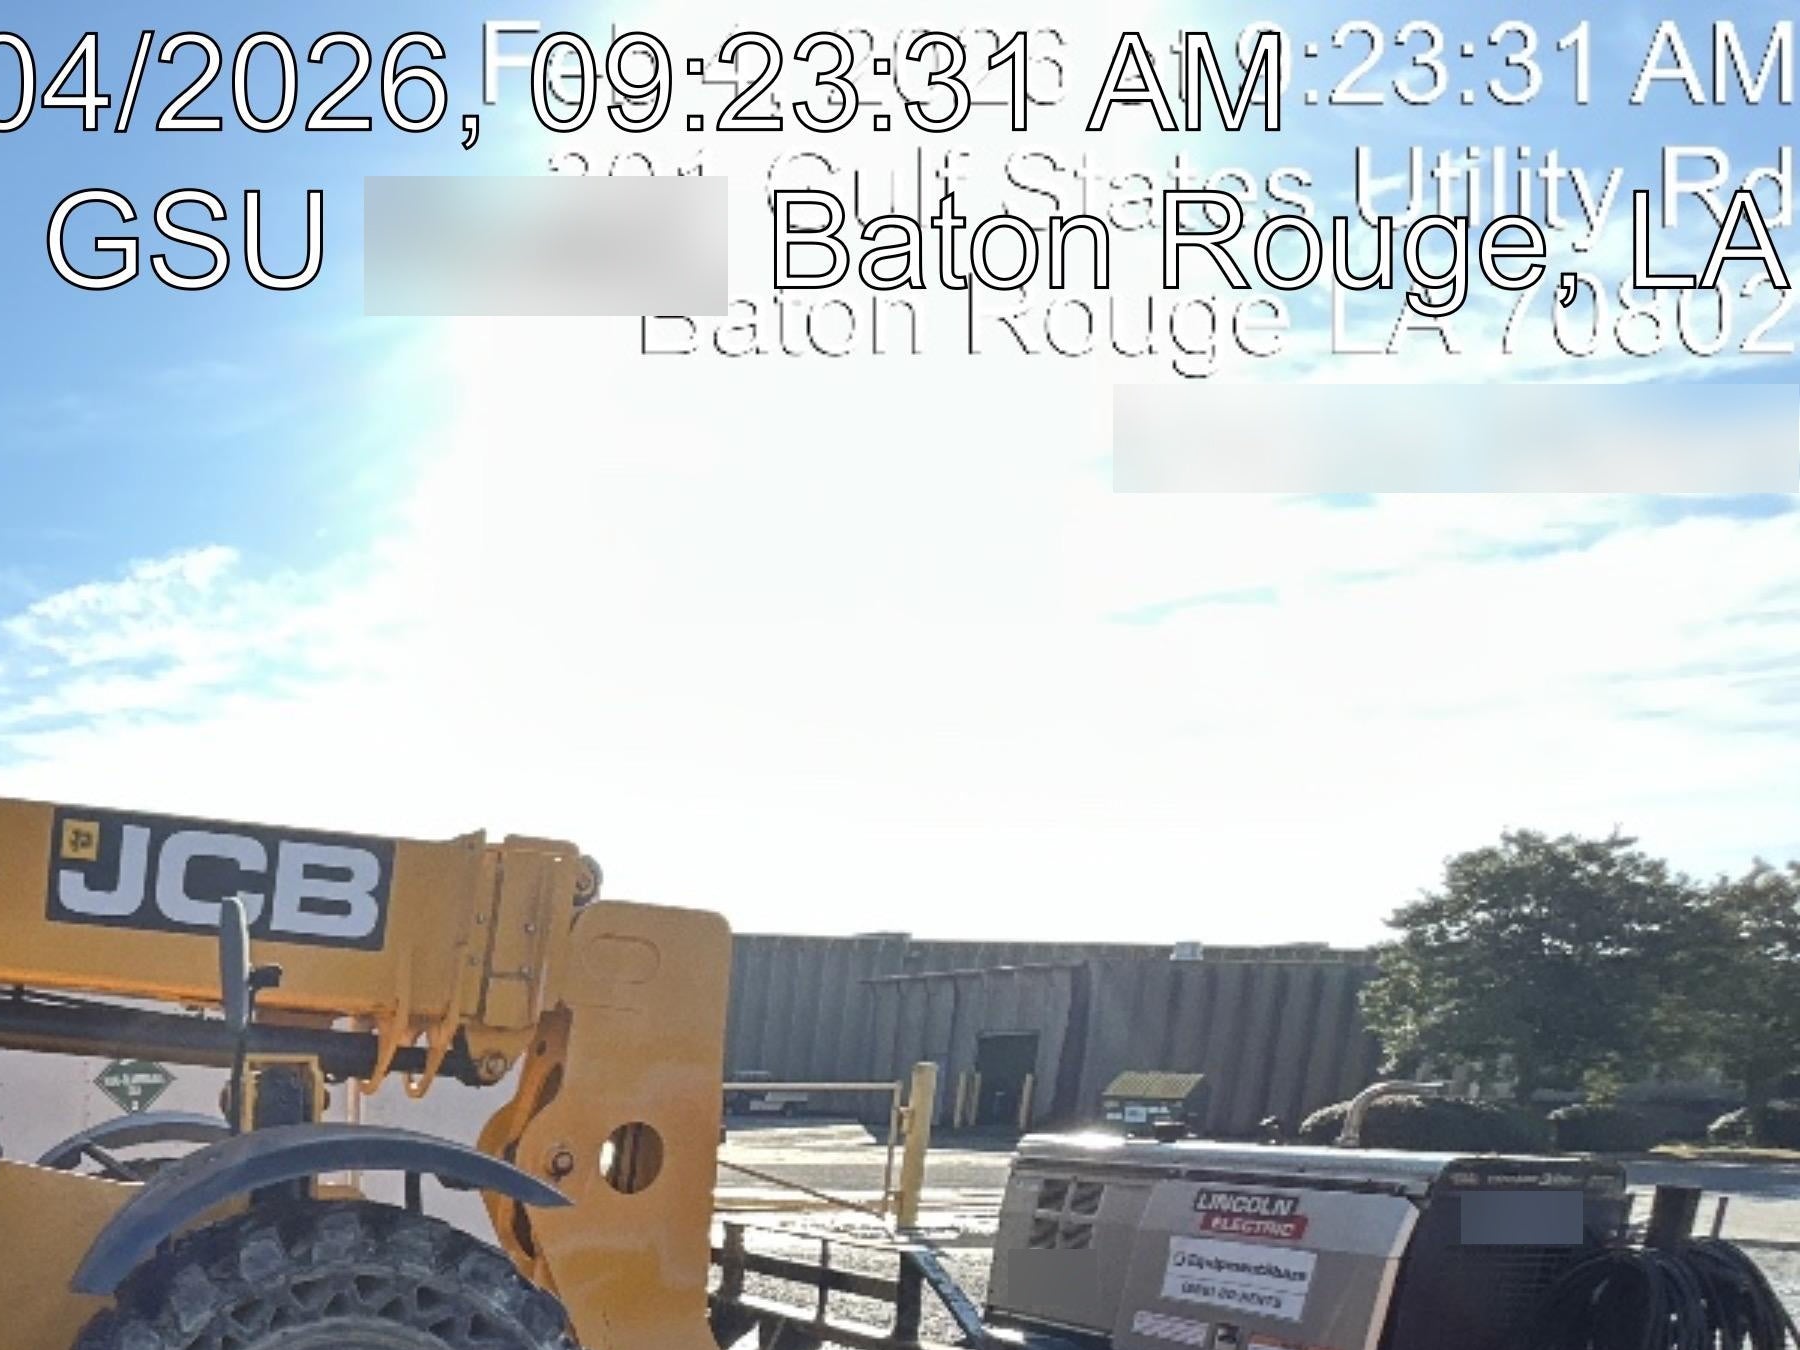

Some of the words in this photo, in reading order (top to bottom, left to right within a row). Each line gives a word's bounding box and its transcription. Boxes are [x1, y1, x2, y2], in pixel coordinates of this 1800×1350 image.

[58, 823, 383, 939] JCB
[1196, 1192, 1296, 1218] LINCOLN
[1210, 1216, 1298, 1238] ELECTRIC
